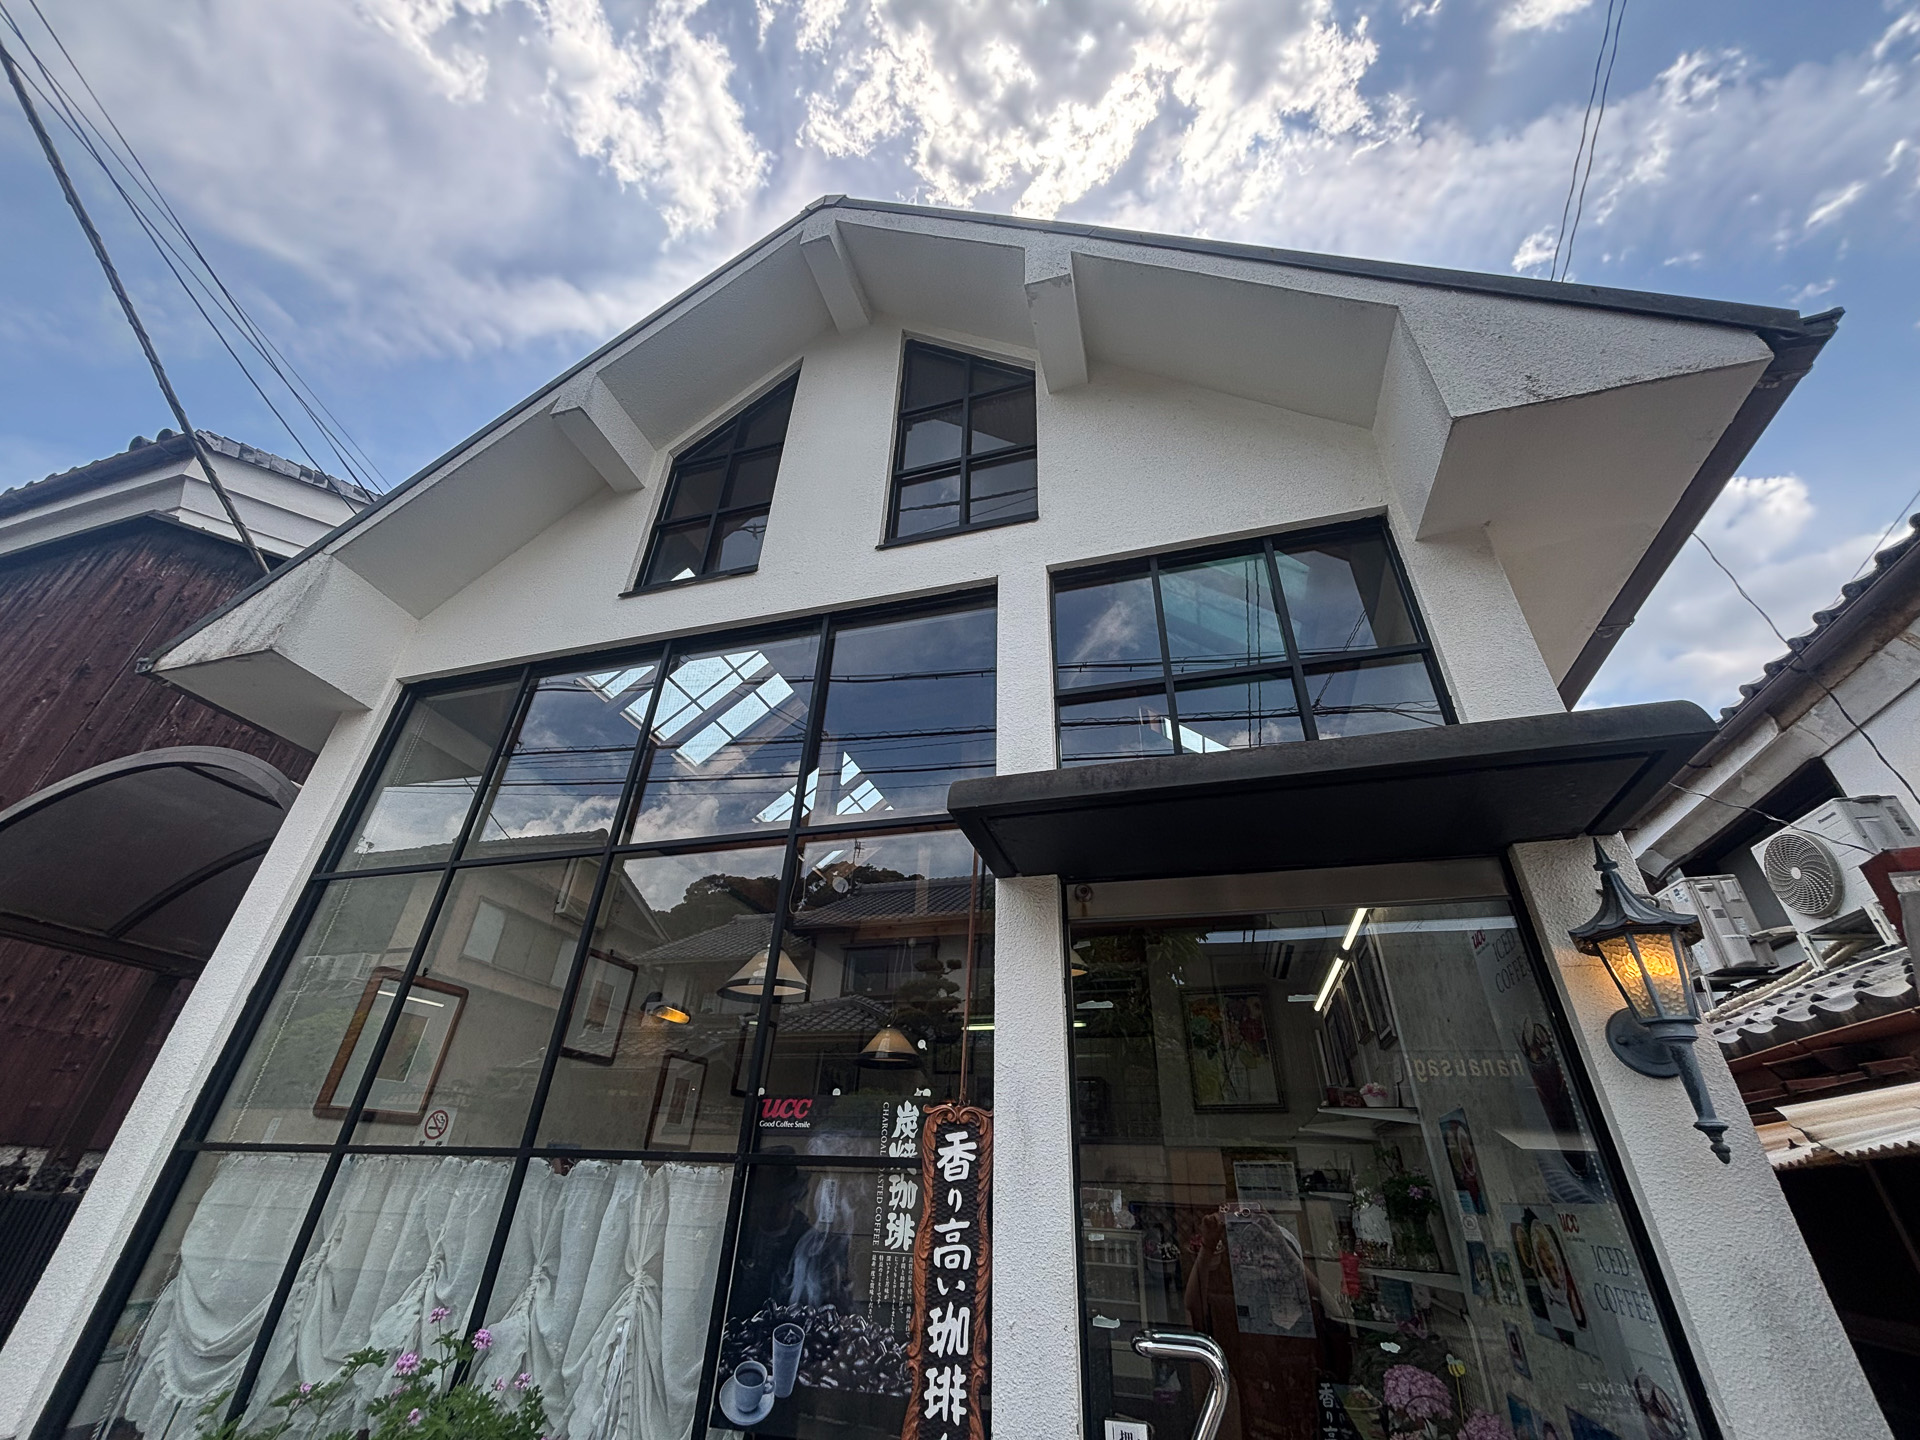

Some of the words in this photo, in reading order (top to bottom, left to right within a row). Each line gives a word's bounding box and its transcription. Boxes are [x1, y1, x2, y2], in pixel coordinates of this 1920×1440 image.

[1492, 929, 1516, 962] ICED
[759, 1120, 775, 1128] Good
[761, 1098, 813, 1119] UCC
[880, 1101, 890, 1156] CHARCOAL
[877, 1168, 885, 1204] ASTED
[872, 1206, 883, 1246] COFFEE
[1558, 1213, 1580, 1233] UCC
[1591, 1245, 1630, 1277] ICED
[923, 1131, 978, 1440] 香り高い珈琲
[1594, 1282, 1657, 1324] COFFEE
